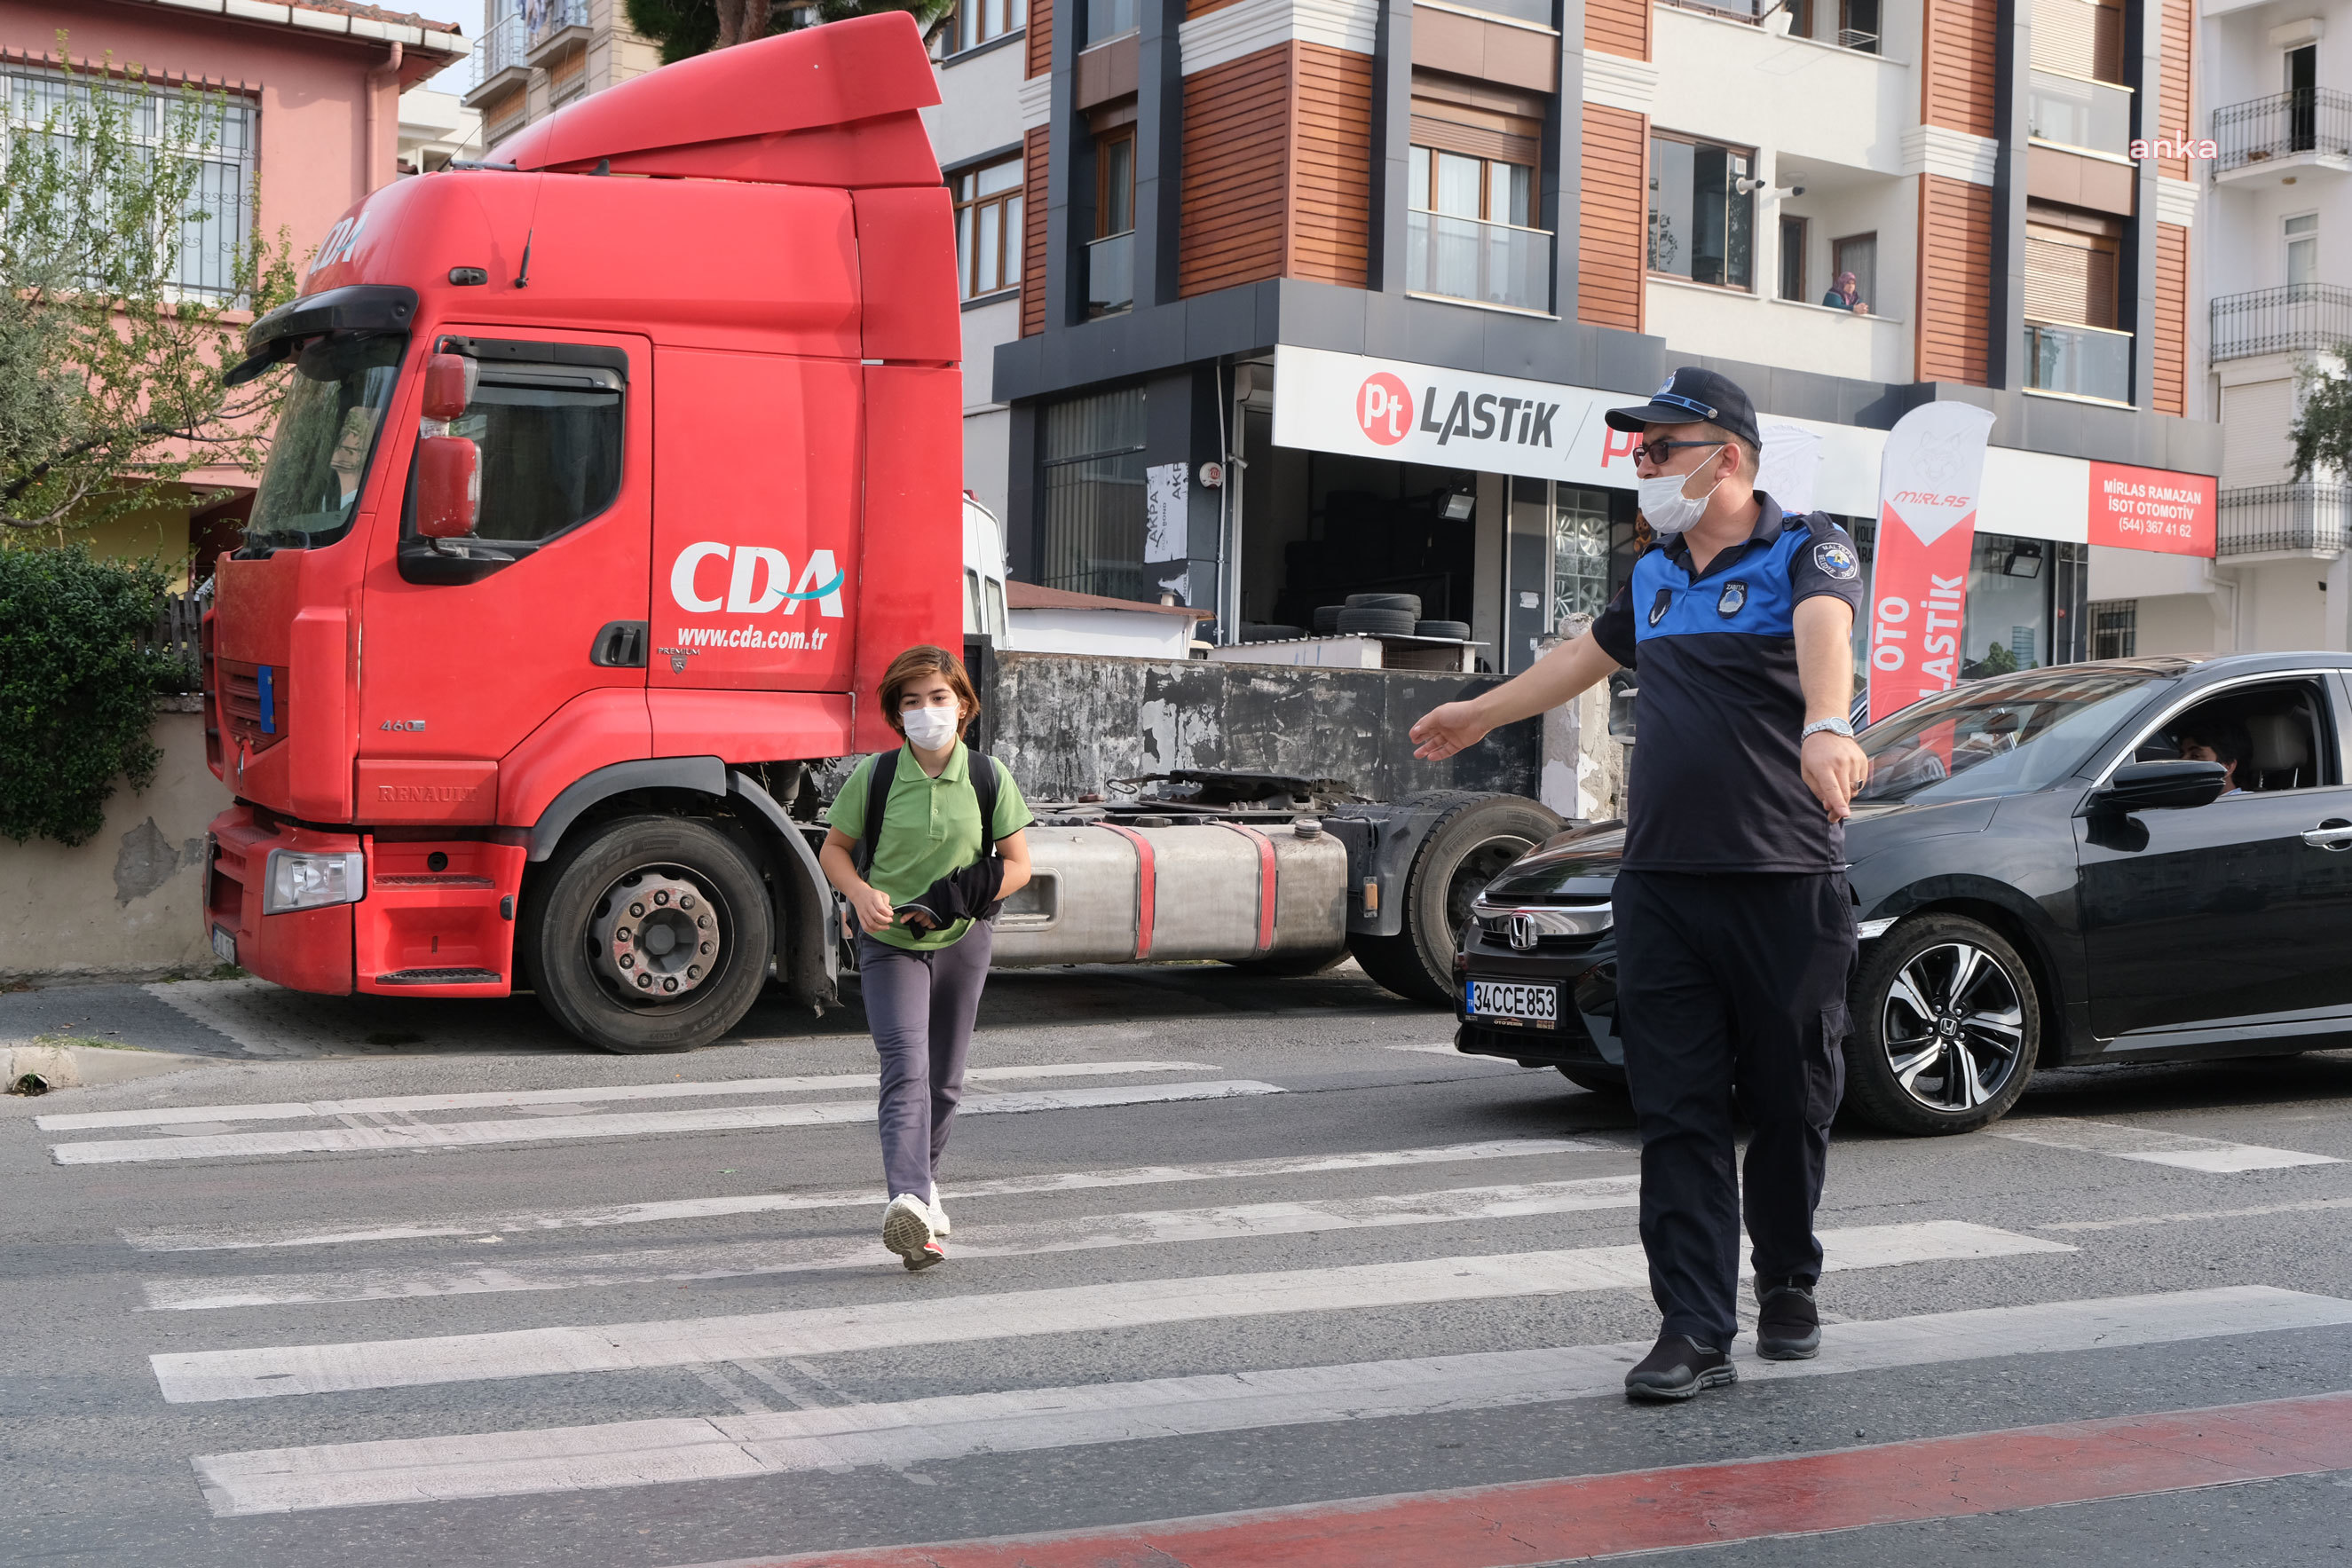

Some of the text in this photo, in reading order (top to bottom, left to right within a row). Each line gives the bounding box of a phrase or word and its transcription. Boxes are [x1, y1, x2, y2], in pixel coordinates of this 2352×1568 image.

[309, 210, 370, 275] CDA
[2103, 478, 2202, 505] MİRLAS RAMAZAN
[2108, 495, 2195, 521] İSOT OTOMOTİV
[2119, 516, 2192, 538] (544) 367 41 62
[670, 541, 845, 618] CDA
[677, 624, 828, 650] www.cda.com.tr
[1873, 596, 1910, 672] OTO
[658, 647, 700, 656] PREMIUM
[377, 785, 478, 802] RENAULT
[1474, 984, 1556, 1017] 34CCE853
